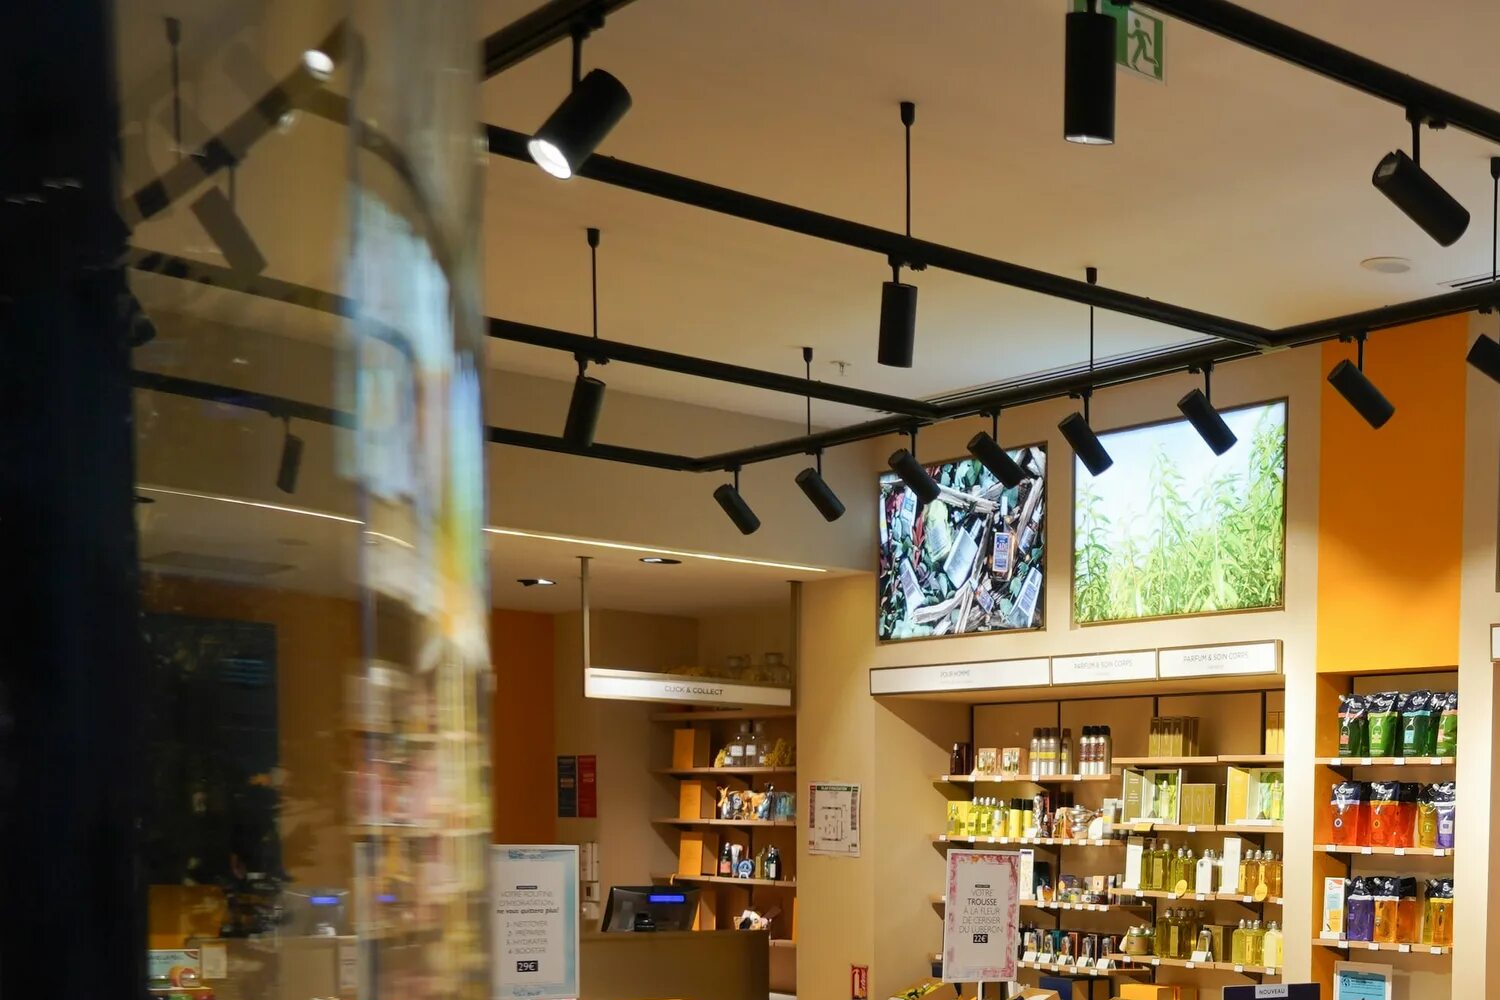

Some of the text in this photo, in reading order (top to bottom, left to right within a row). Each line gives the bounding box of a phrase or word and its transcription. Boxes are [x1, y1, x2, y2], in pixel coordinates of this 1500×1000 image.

[664, 685, 685, 693] CLICK
[692, 688, 723, 696] COLLECT
[972, 889, 993, 897] VOTRE
[967, 898, 997, 906] TROUSSE
[981, 907, 1000, 915] FLEUR
[518, 962, 536, 971] 29€
